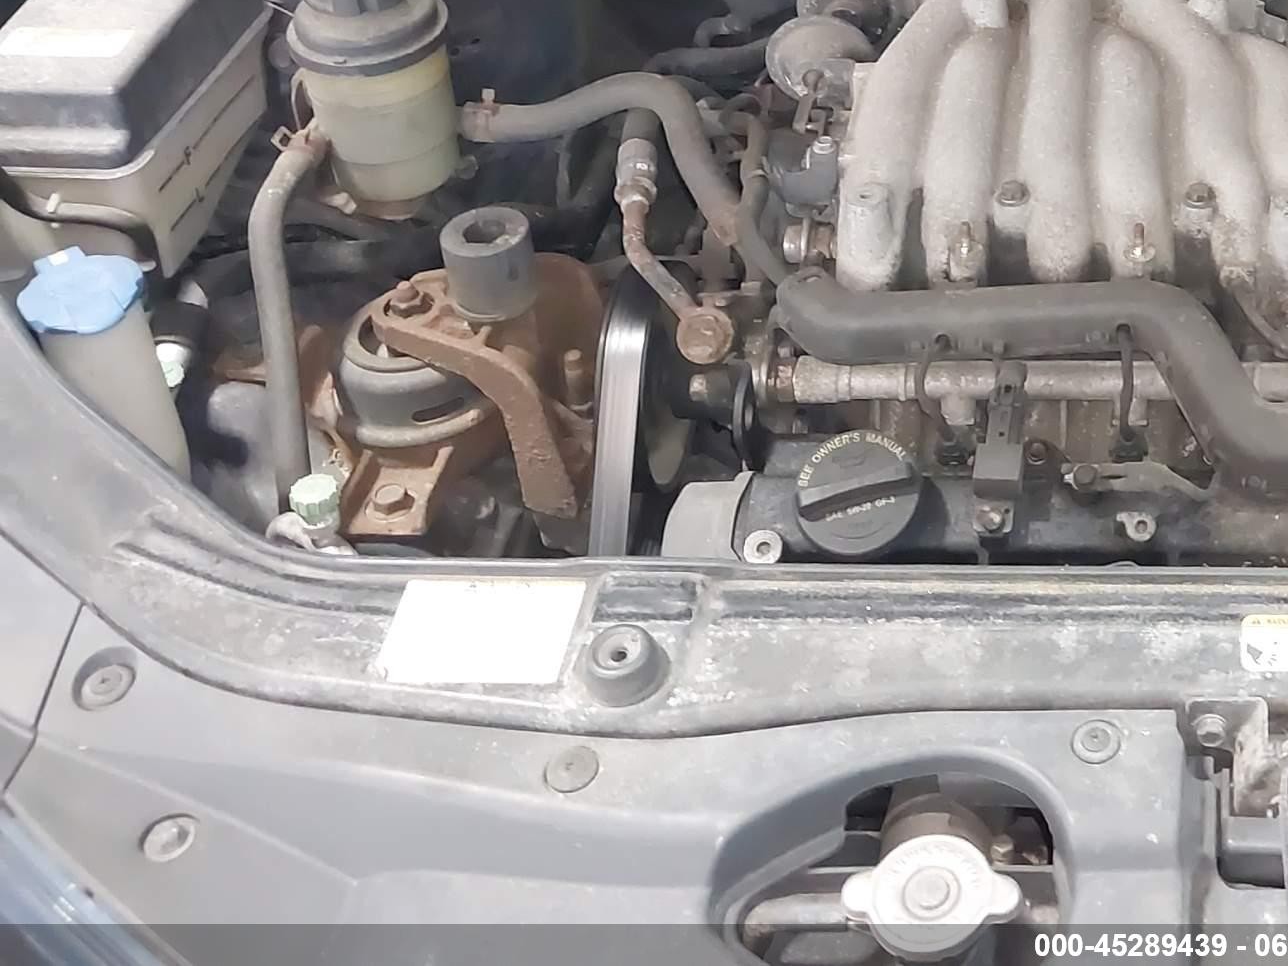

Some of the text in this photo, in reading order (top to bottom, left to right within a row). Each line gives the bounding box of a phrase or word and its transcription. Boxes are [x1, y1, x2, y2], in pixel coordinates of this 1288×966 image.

[797, 432, 907, 487] SEE OWNER'S MANUAL
